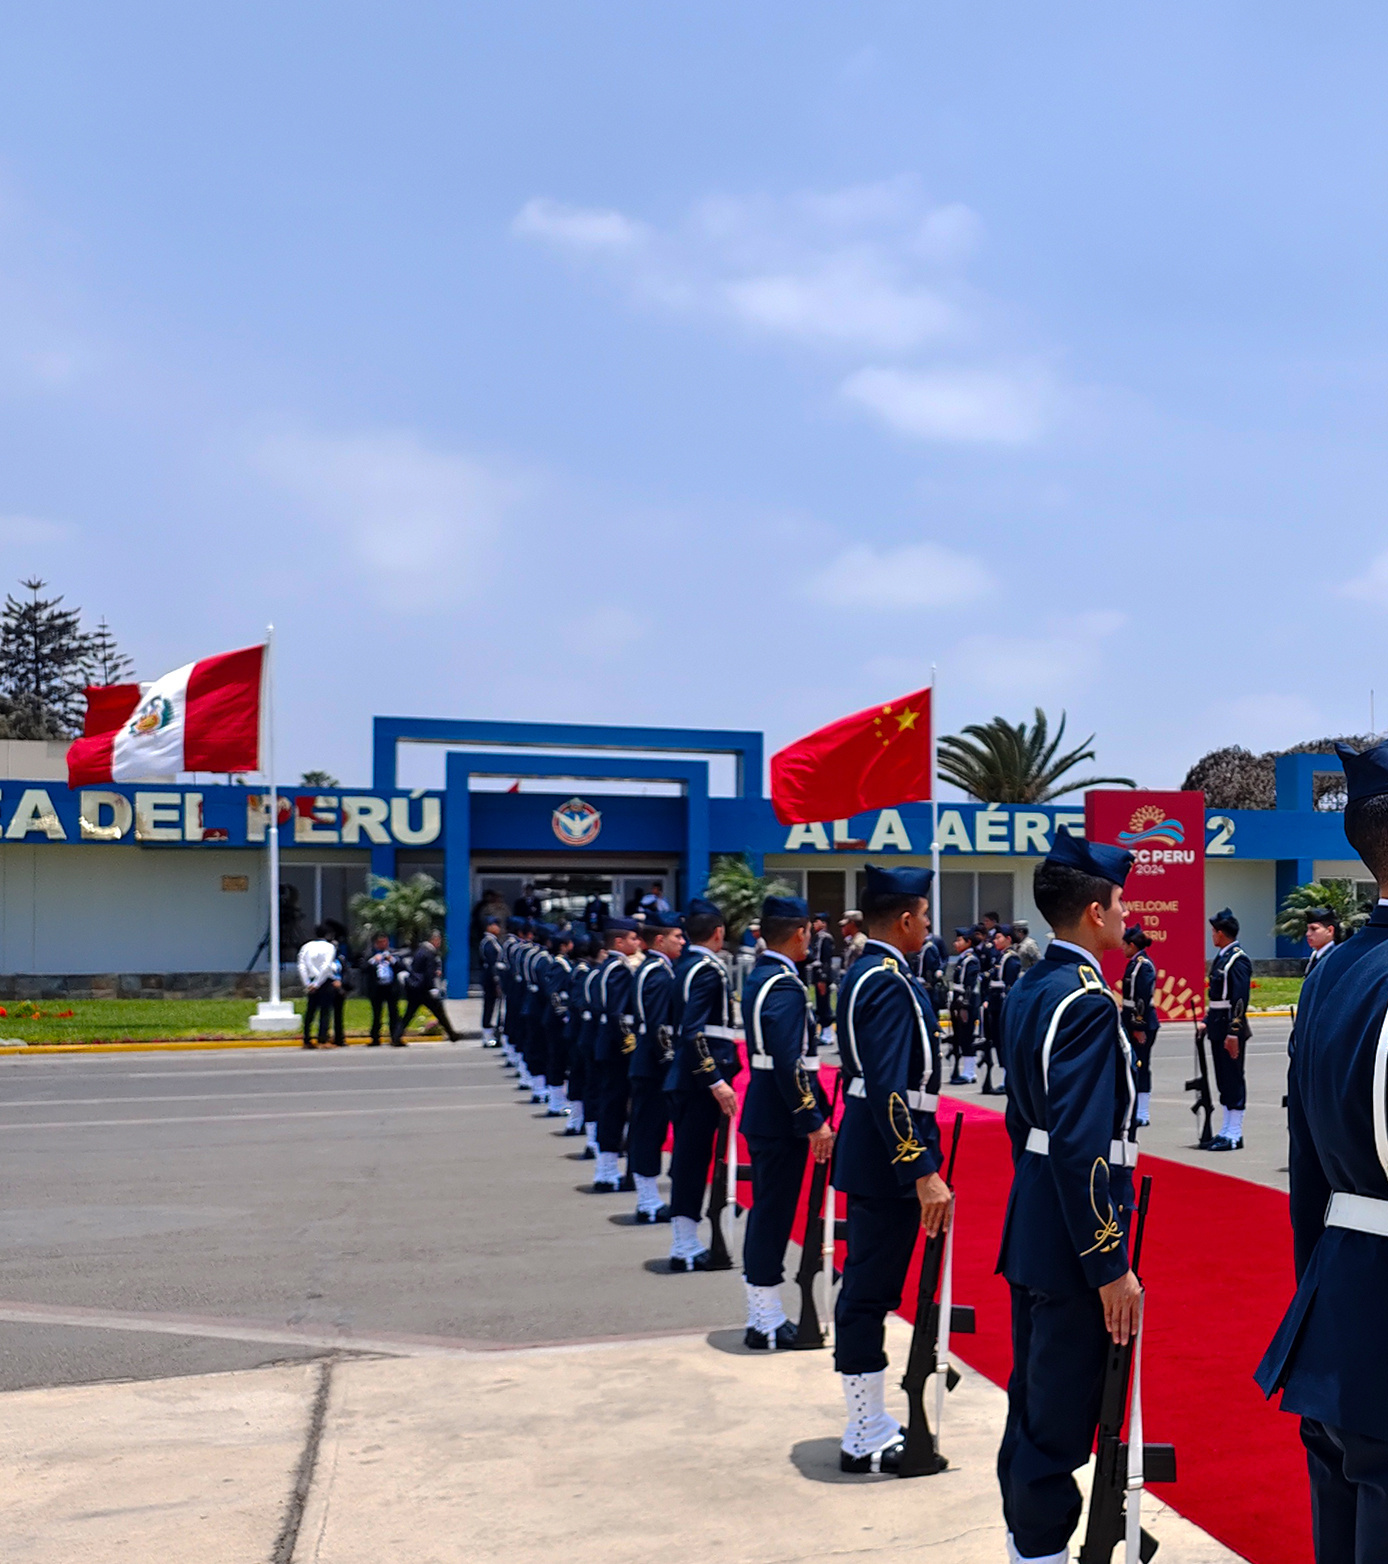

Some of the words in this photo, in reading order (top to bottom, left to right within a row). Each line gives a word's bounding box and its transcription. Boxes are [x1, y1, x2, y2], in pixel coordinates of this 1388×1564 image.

[0, 788, 67, 840] A
[79, 790, 229, 842] DEL
[246, 789, 441, 845] PERÚ
[784, 808, 912, 850] ALA
[1205, 815, 1236, 855] 2
[1152, 849, 1195, 864] PERU
[1135, 864, 1166, 875] 2024
[1123, 900, 1179, 912] WELCOME
[1142, 915, 1160, 927] TO
